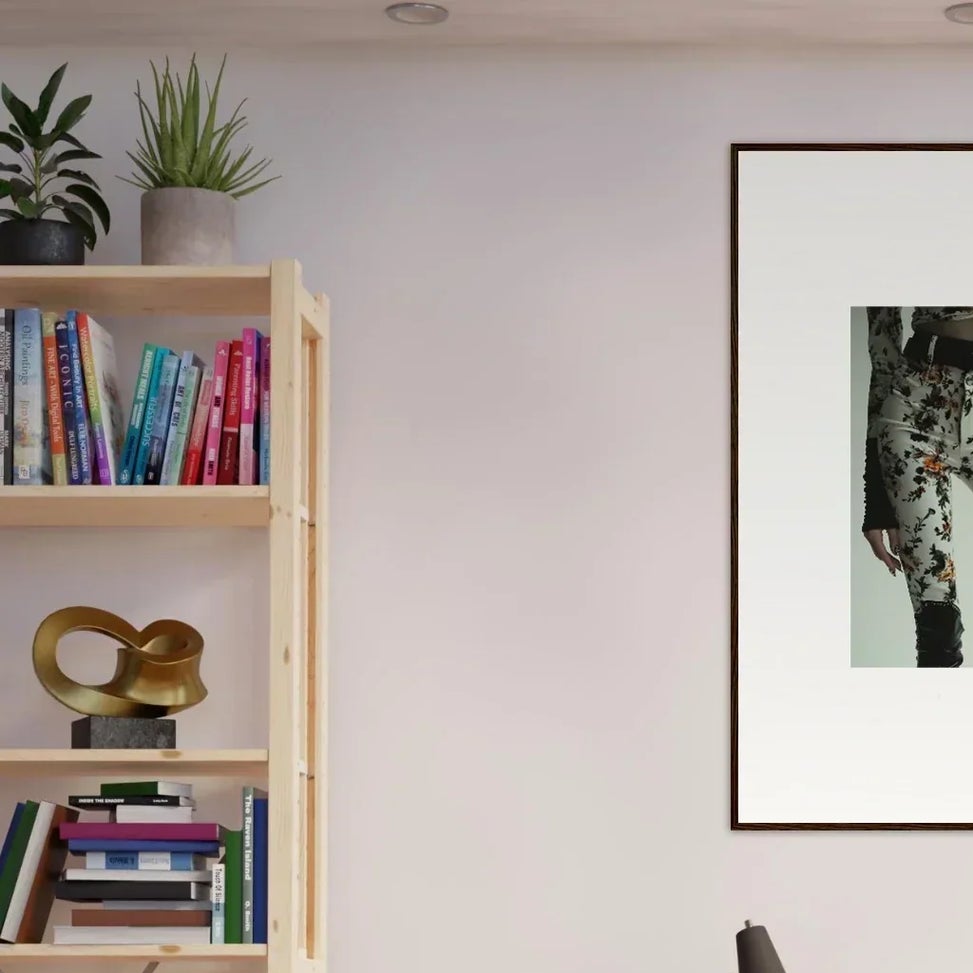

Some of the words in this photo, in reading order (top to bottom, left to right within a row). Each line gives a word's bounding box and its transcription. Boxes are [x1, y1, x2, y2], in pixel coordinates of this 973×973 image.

[21, 325, 33, 339] Oil
[19, 343, 32, 386] Paintings
[58, 344, 74, 409] ICONIC
